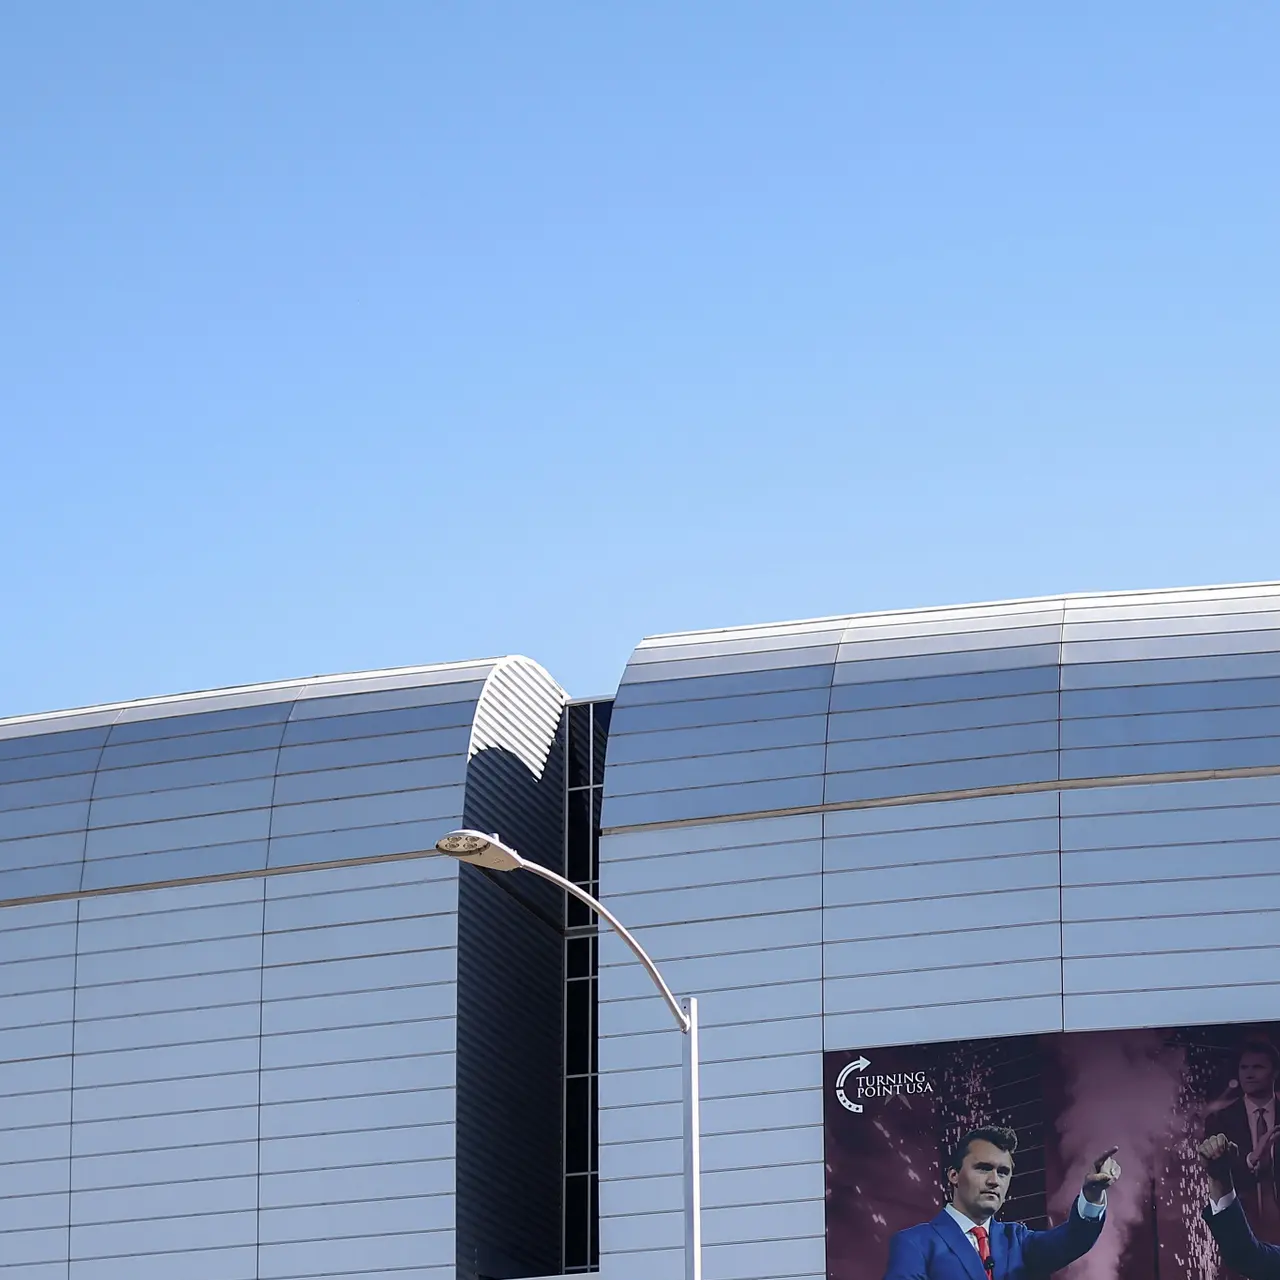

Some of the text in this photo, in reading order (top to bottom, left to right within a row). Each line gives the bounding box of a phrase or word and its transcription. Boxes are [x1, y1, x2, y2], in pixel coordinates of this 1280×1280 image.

[855, 1071, 926, 1088] TURNING
[857, 1081, 934, 1099] POINT USA
